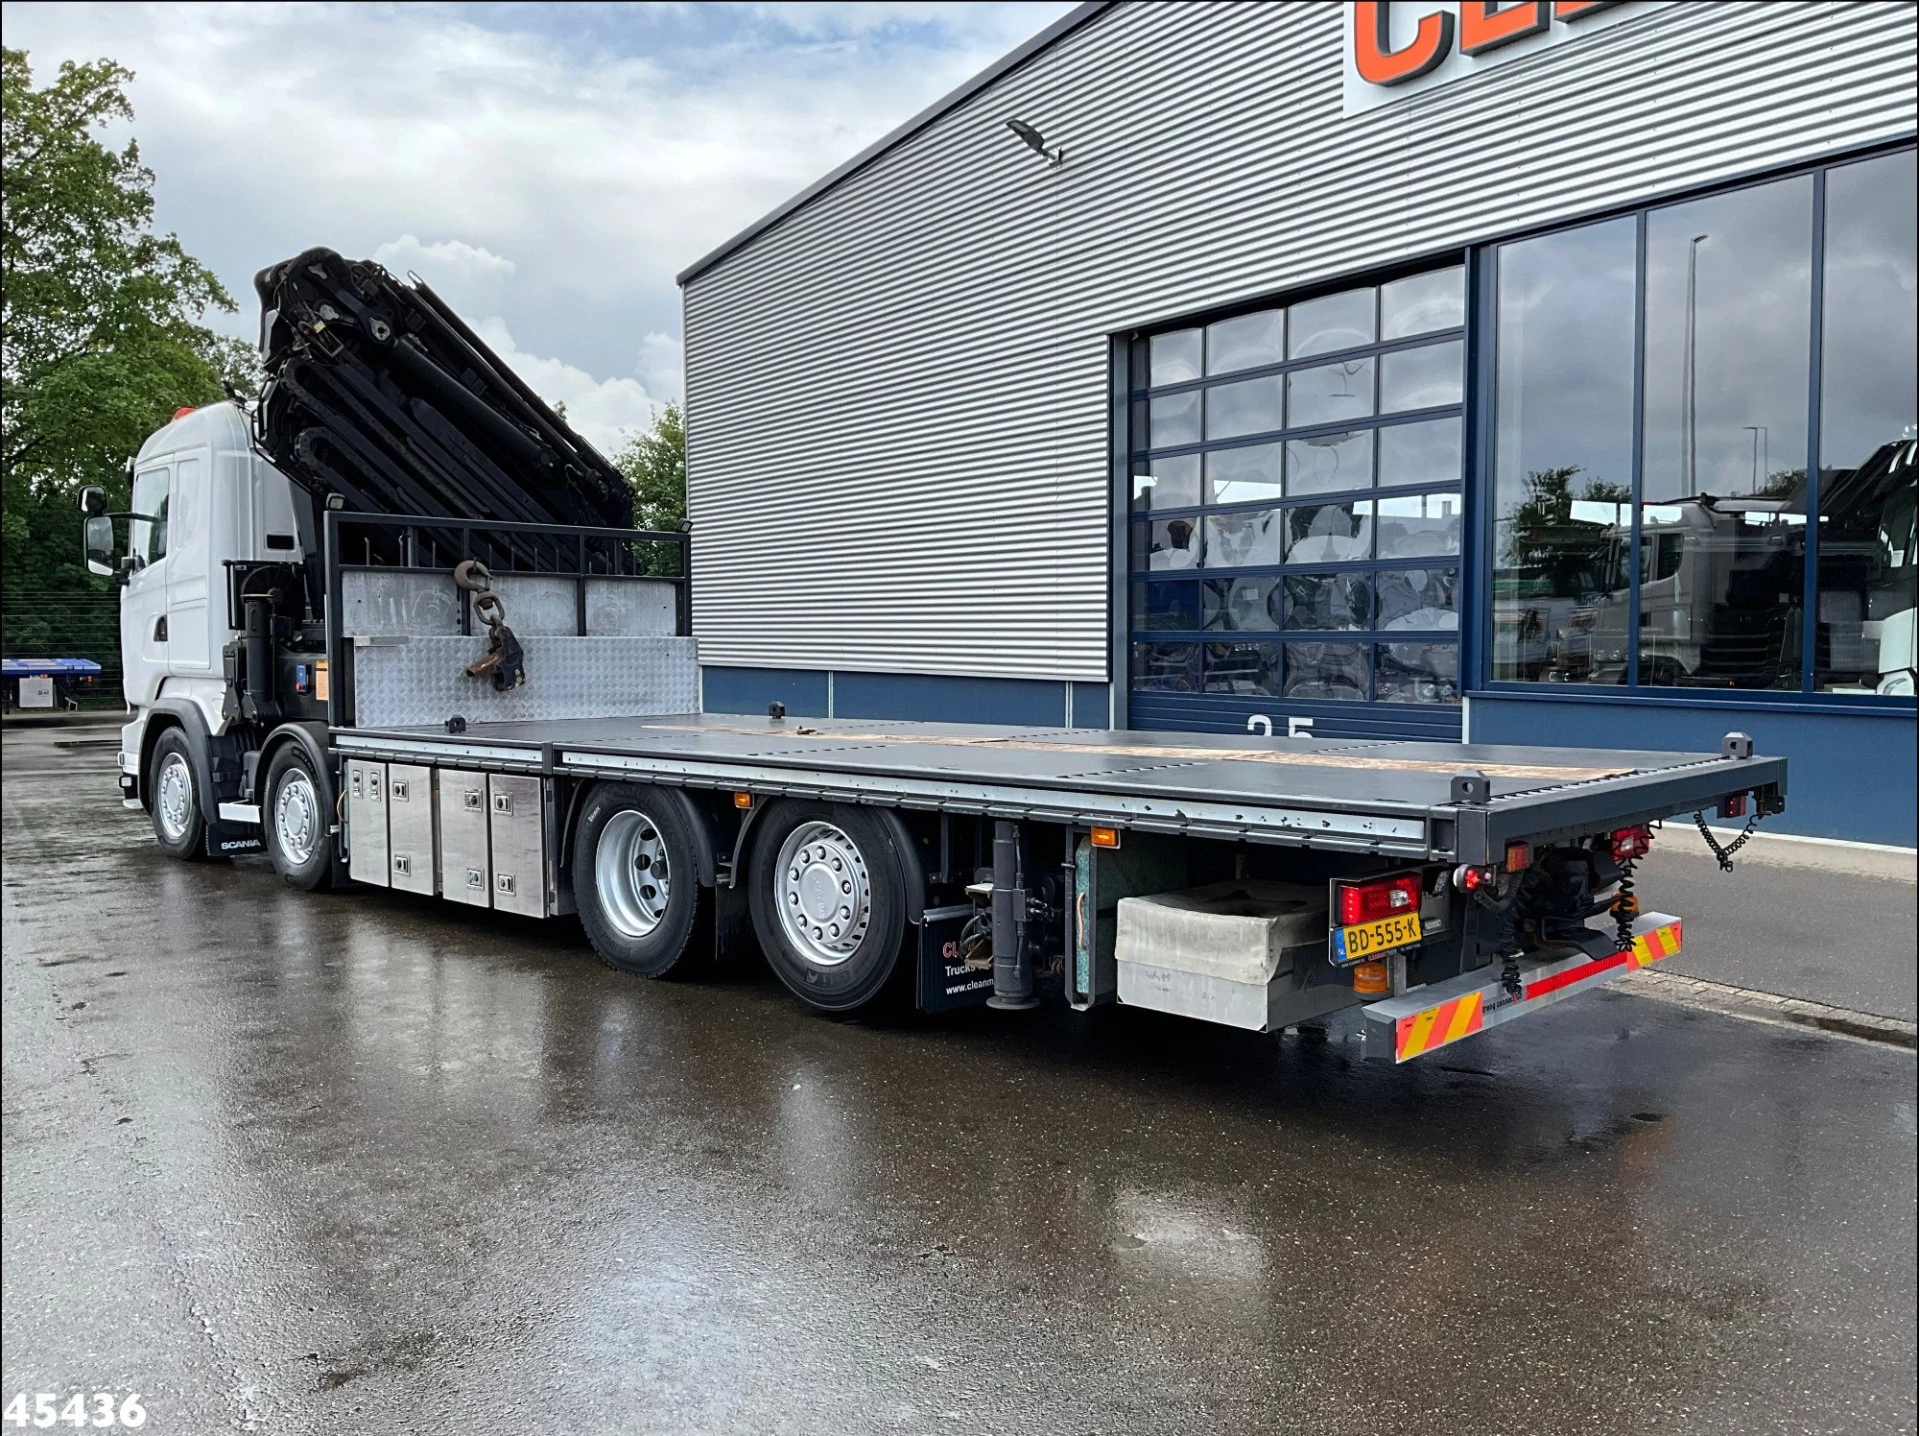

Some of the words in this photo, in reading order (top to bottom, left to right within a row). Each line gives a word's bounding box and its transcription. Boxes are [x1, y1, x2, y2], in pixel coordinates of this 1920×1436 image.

[221, 839, 261, 850] SCANIA
[1347, 916, 1417, 954] BD-555-K
[945, 964, 976, 977] Trucks
